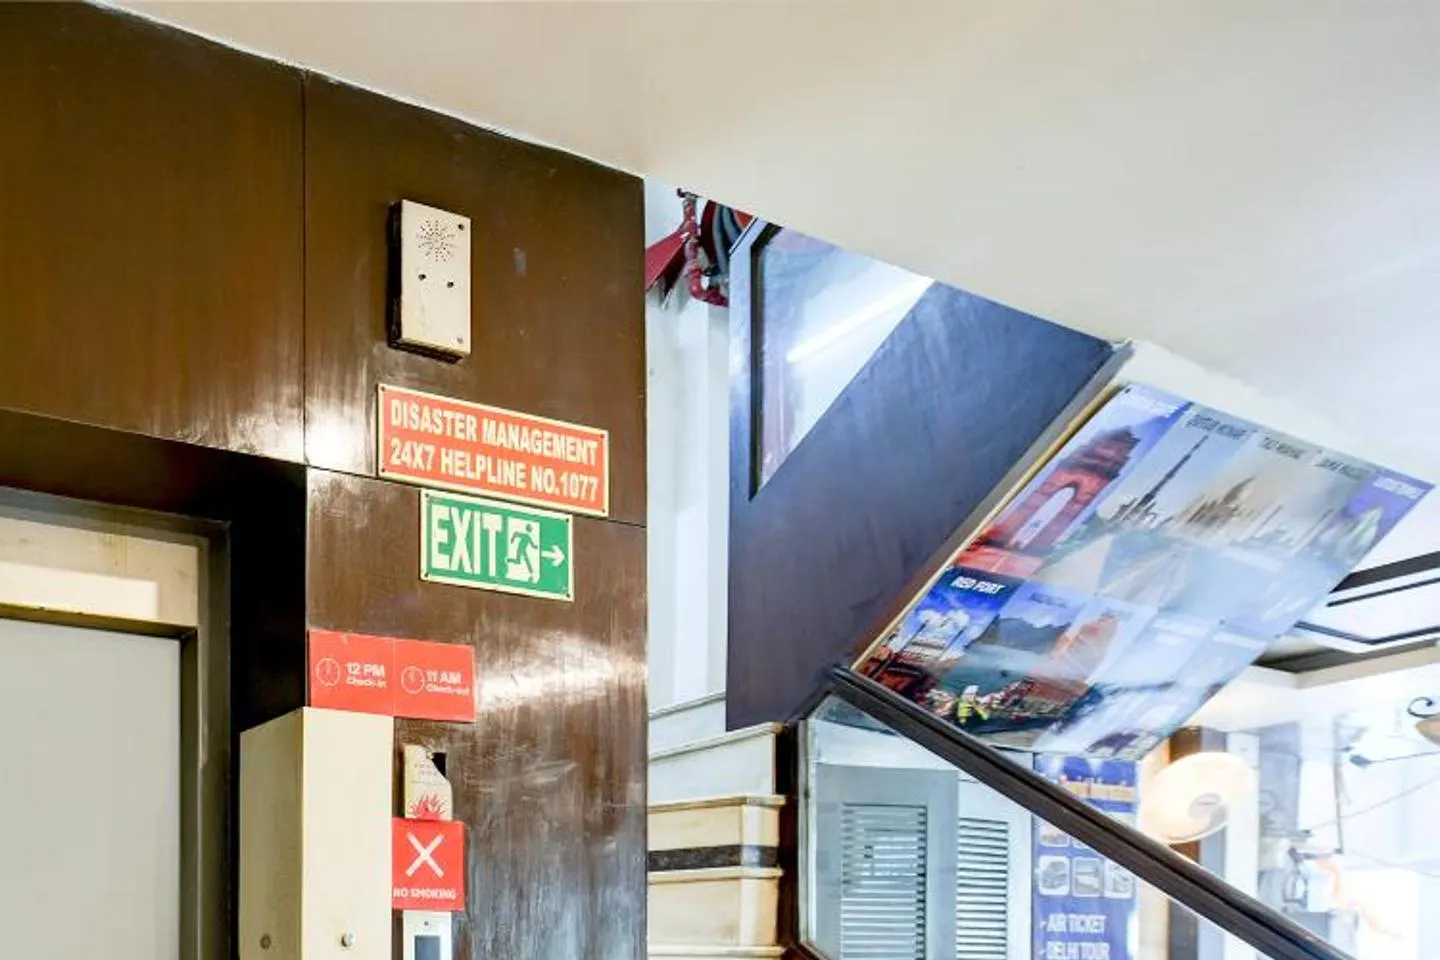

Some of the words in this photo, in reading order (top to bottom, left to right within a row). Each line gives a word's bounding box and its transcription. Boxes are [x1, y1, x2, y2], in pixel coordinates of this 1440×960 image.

[390, 398, 477, 442] DISASTER
[482, 417, 599, 467] MANAGEMENT
[389, 437, 436, 470] 24X7
[440, 446, 527, 489] HELPLINE
[430, 503, 504, 578] EXIT
[346, 662, 361, 674] 12
[363, 663, 385, 678] PM
[425, 670, 437, 682] 11
[439, 672, 462, 685] AM
[393, 887, 409, 898] NO
[410, 887, 457, 900] SMOKING
